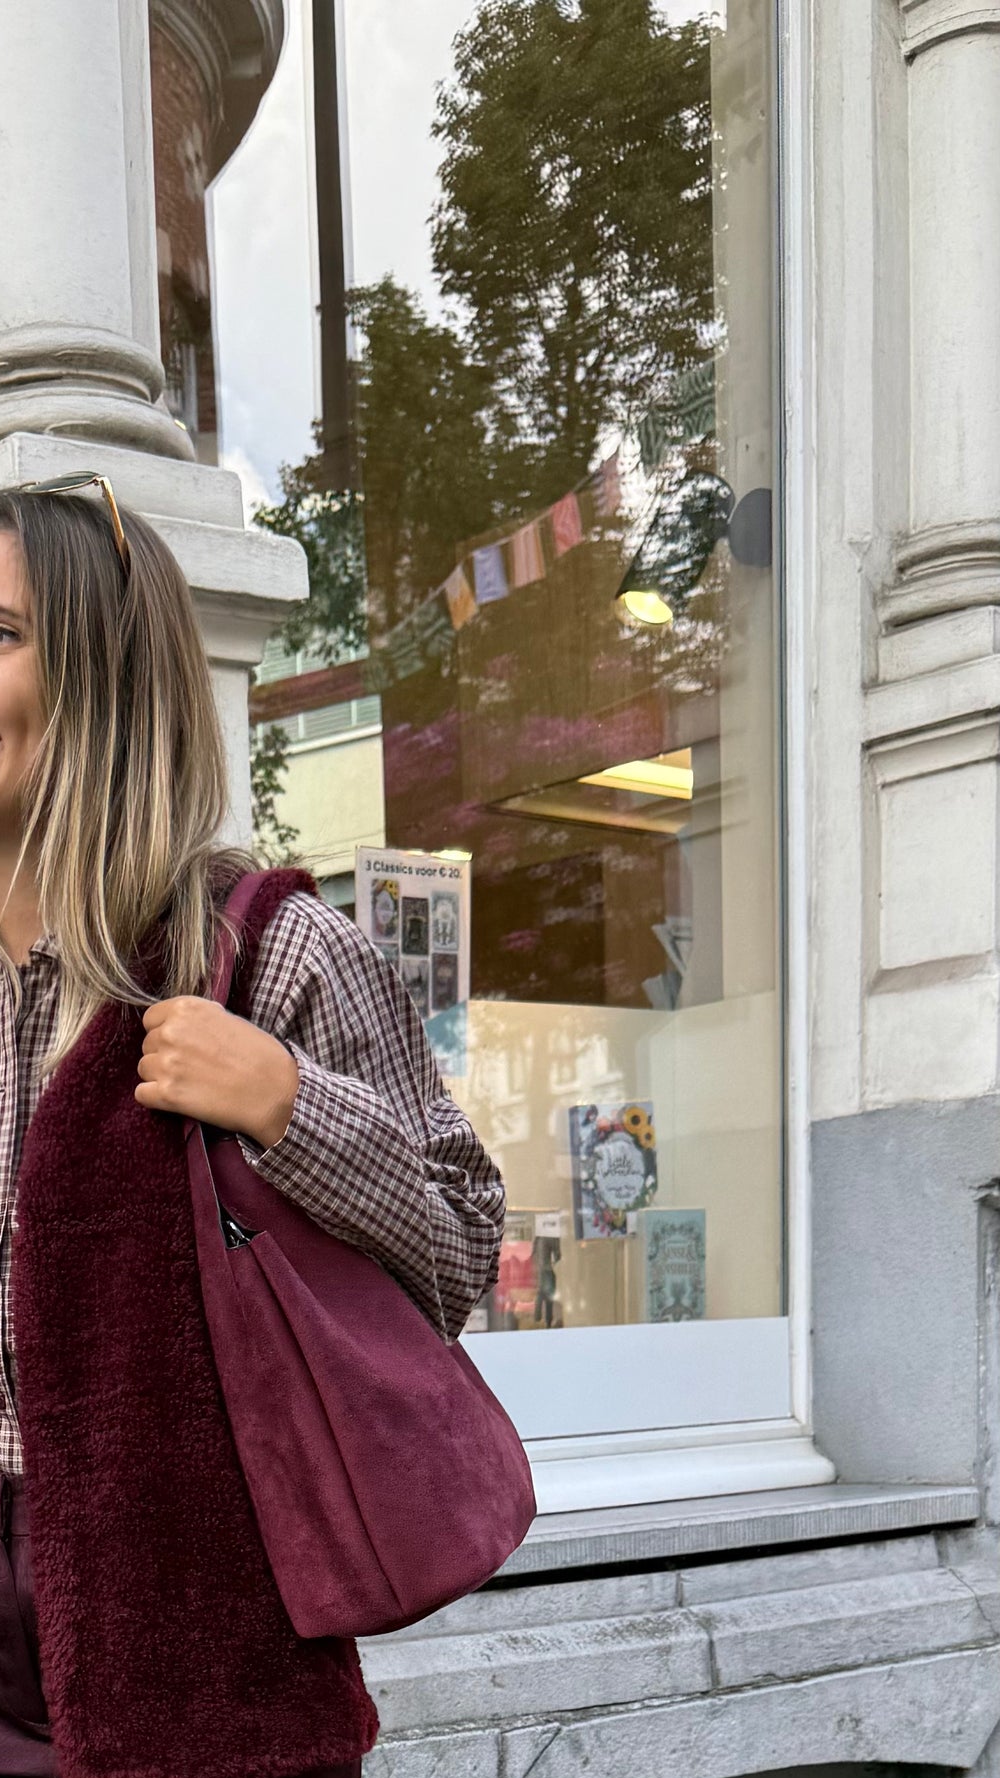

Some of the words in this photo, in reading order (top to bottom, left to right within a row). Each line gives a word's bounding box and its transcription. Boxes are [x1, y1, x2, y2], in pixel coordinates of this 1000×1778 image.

[366, 861, 372, 871] 3
[373, 861, 413, 875] Classics
[415, 867, 438, 877] voor
